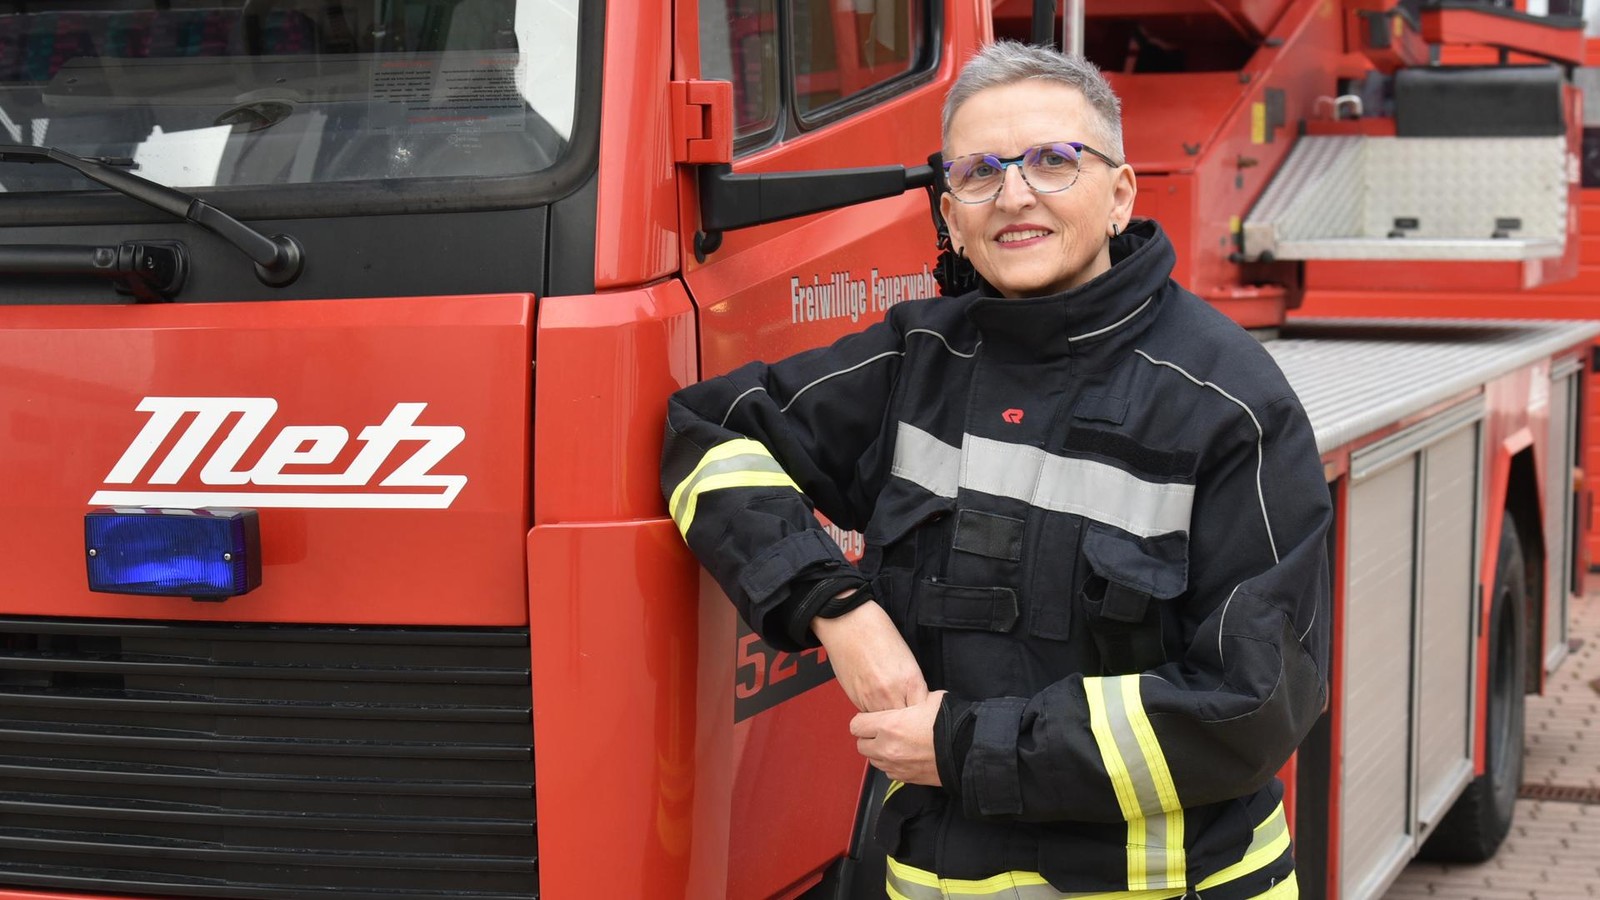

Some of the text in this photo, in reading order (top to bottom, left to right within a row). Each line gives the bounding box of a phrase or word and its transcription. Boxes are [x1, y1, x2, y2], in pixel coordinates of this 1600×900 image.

[790, 263, 937, 323] Freiwillige Feuerwehr
[88, 396, 468, 508] Metz
